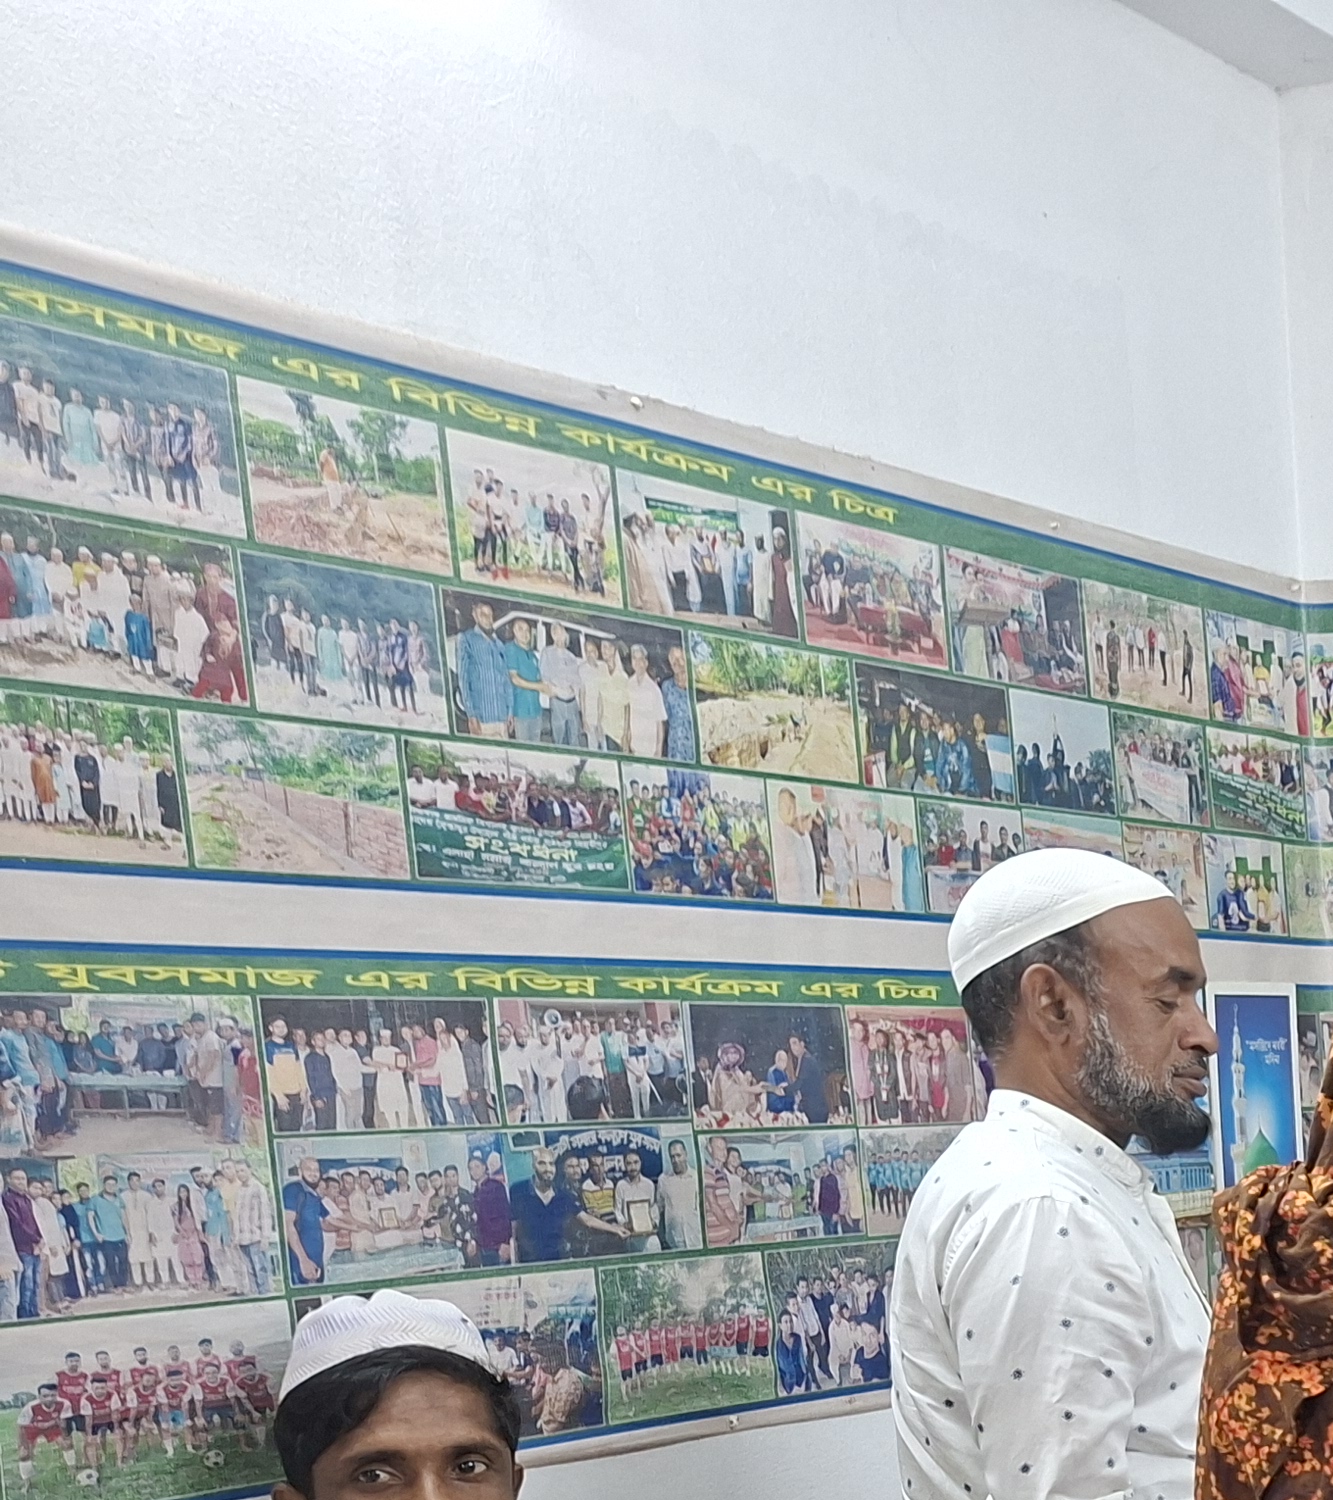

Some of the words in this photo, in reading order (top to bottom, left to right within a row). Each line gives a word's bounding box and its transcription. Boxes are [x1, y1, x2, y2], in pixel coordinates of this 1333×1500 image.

[0, 281, 246, 362] বসমাজ
[272, 356, 363, 393] এর
[383, 376, 542, 439] বিভিন্ন
[556, 421, 737, 484] কার্যক্রম
[751, 475, 819, 504] এর
[828, 488, 900, 525] চিত্র
[35, 963, 323, 991] যুবসমাজ
[345, 971, 436, 990] এর
[450, 966, 600, 997] বিভিন্ন
[612, 974, 785, 997] কার্যক্রম
[800, 978, 862, 999] এর
[875, 978, 941, 1001] চিত্র
